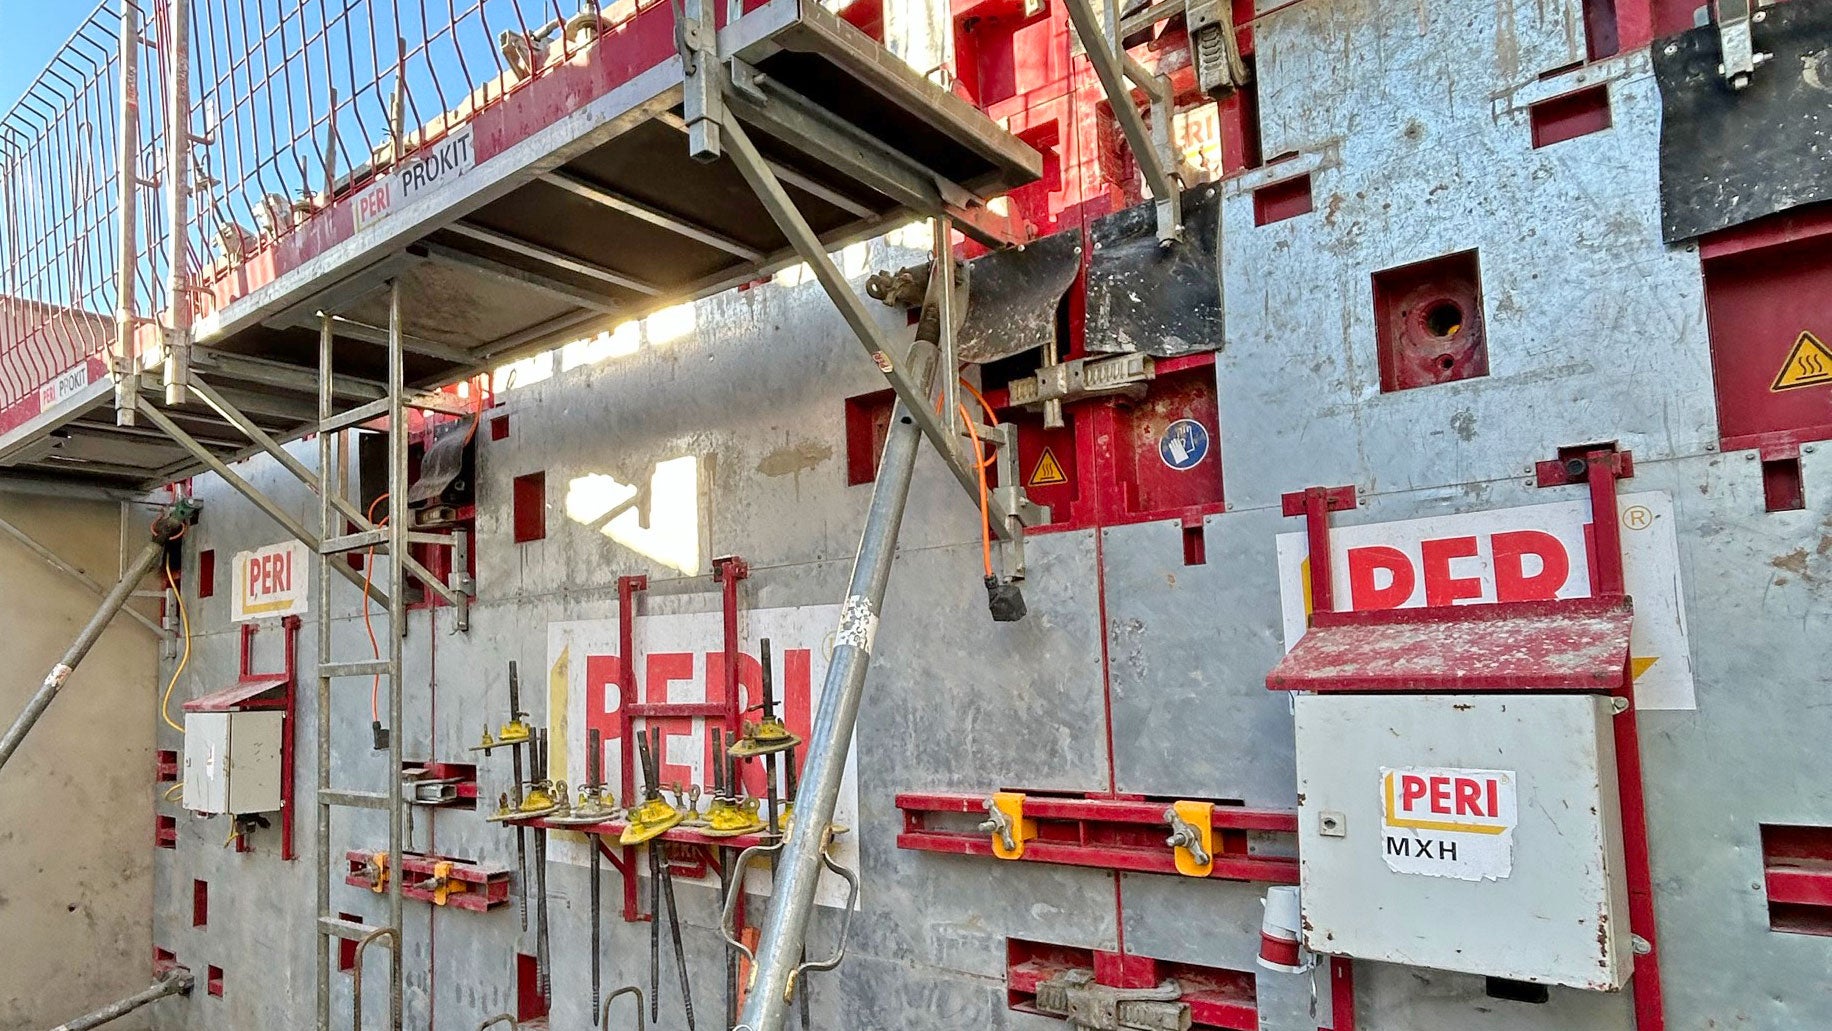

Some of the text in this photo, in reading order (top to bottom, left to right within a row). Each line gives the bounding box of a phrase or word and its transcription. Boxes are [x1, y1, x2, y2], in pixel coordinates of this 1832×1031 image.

[360, 132, 470, 222] PERI PROKIT
[249, 551, 292, 597] PERI
[1348, 523, 1596, 612] PER
[586, 648, 812, 800] PERI
[1402, 775, 1499, 818] PERI
[1386, 836, 1457, 861] MXH
